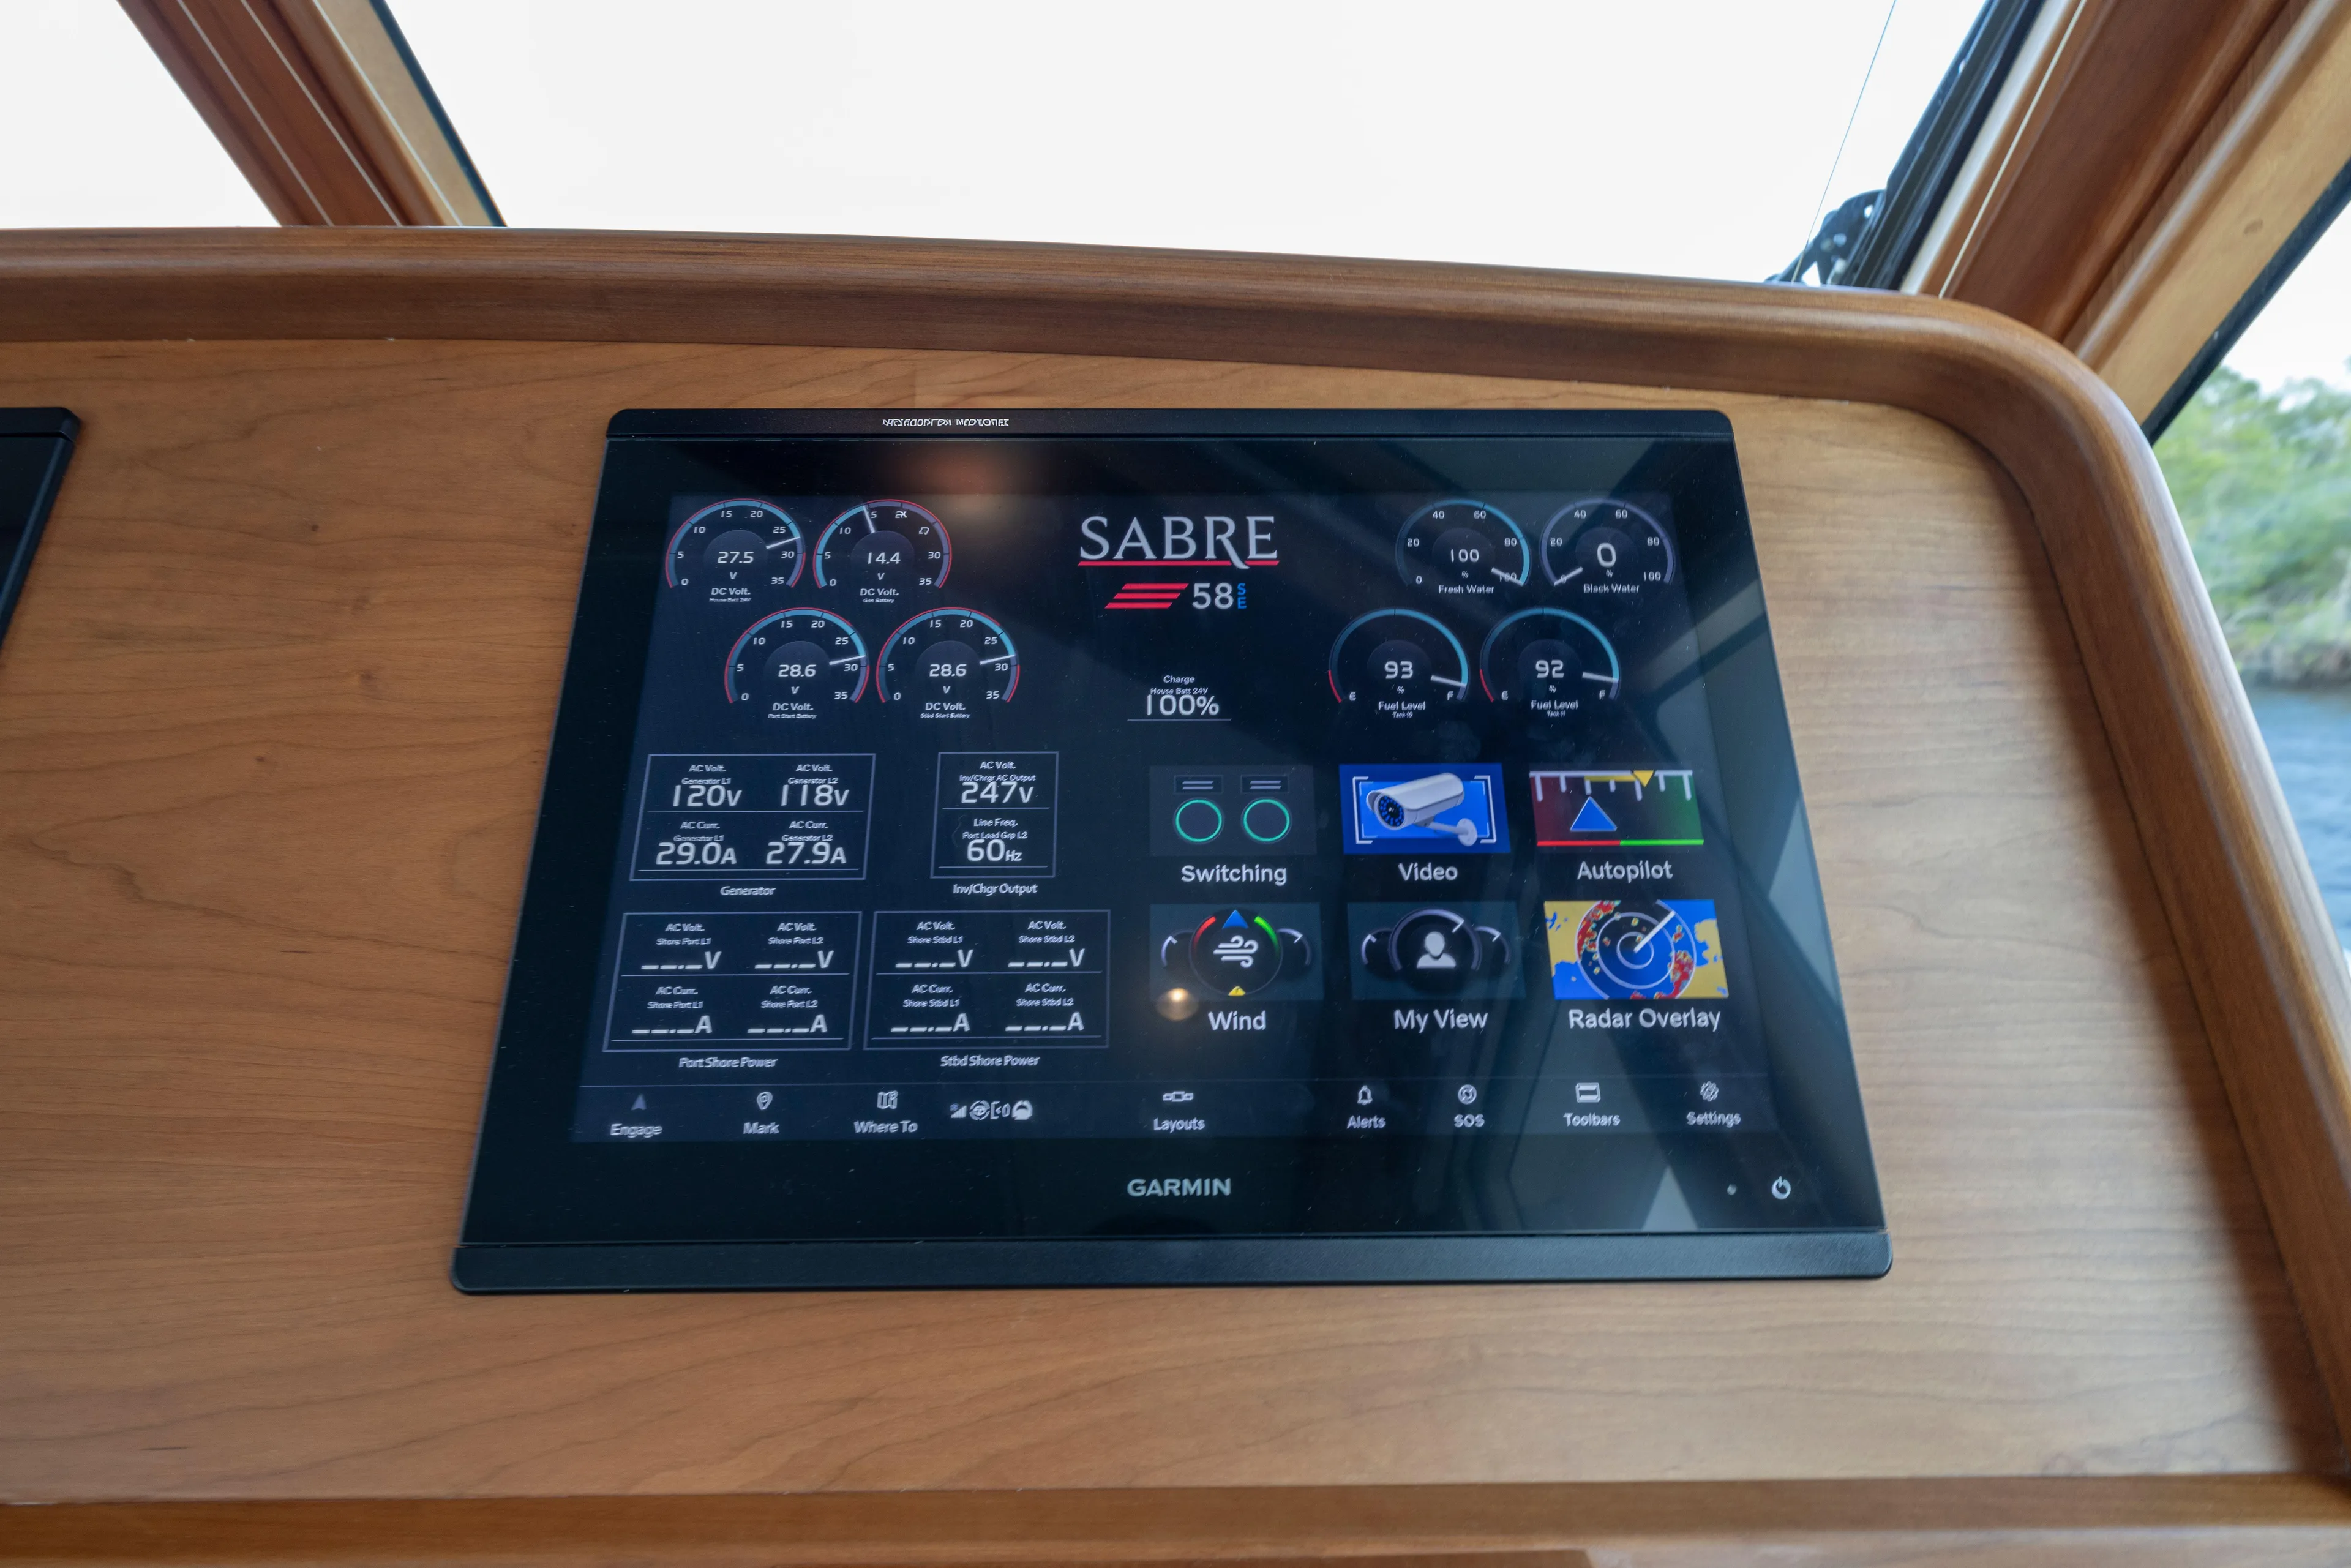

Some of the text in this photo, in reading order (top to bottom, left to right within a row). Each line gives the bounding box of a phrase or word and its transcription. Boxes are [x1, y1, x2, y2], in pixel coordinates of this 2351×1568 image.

[1081, 516, 1278, 569] SABRE
[1408, 538, 1419, 547] 20
[1551, 538, 1562, 546] 20
[1648, 537, 1659, 546] 80
[718, 552, 754, 563] 27.5
[868, 552, 901, 564] 14.4
[1451, 549, 1479, 562] 100
[1597, 543, 1616, 567] 0
[1644, 572, 1660, 581] 100
[1439, 585, 1494, 593] Fresh Water
[1584, 584, 1639, 593] Black Water
[1193, 583, 1234, 609] 58
[778, 664, 816, 677] 28.6
[929, 664, 966, 677] 28.6
[1385, 661, 1413, 678] 93
[1535, 660, 1564, 678] 92
[1163, 675, 1194, 684] Charge
[1147, 694, 1219, 715] 100%
[1379, 701, 1425, 710] Fuel Level
[1531, 700, 1578, 710] Fuel Level
[995, 818, 1018, 827] Freq.
[656, 842, 737, 865] 29.0A
[766, 842, 846, 864] 27.9A
[967, 839, 1022, 861] 60Hz
[1182, 864, 1286, 886] Switching
[1398, 862, 1458, 880] Video
[1577, 860, 1673, 883] Autopilot
[721, 887, 776, 895] Generator
[953, 883, 1038, 896] Inv/Chgr Output
[1028, 921, 1043, 929] AC
[912, 985, 928, 993] AC
[1025, 983, 1040, 992] AC
[1208, 1011, 1266, 1030] Wind
[1394, 1008, 1488, 1033] My View
[1569, 1007, 1720, 1032] Radar Overlay
[679, 1057, 778, 1067] Port Shore Power
[940, 1055, 1040, 1066] Stbd Shore Power
[1154, 1117, 1205, 1133] Layouts
[1347, 1116, 1385, 1128] Alerts
[1454, 1114, 1485, 1127] SOS
[1564, 1113, 1620, 1126] Toolbars
[1687, 1111, 1741, 1128] Settings
[611, 1123, 662, 1138] Engage
[743, 1122, 779, 1134] Mark
[854, 1120, 918, 1133] Where To
[1127, 1178, 1231, 1196] GARMIN
